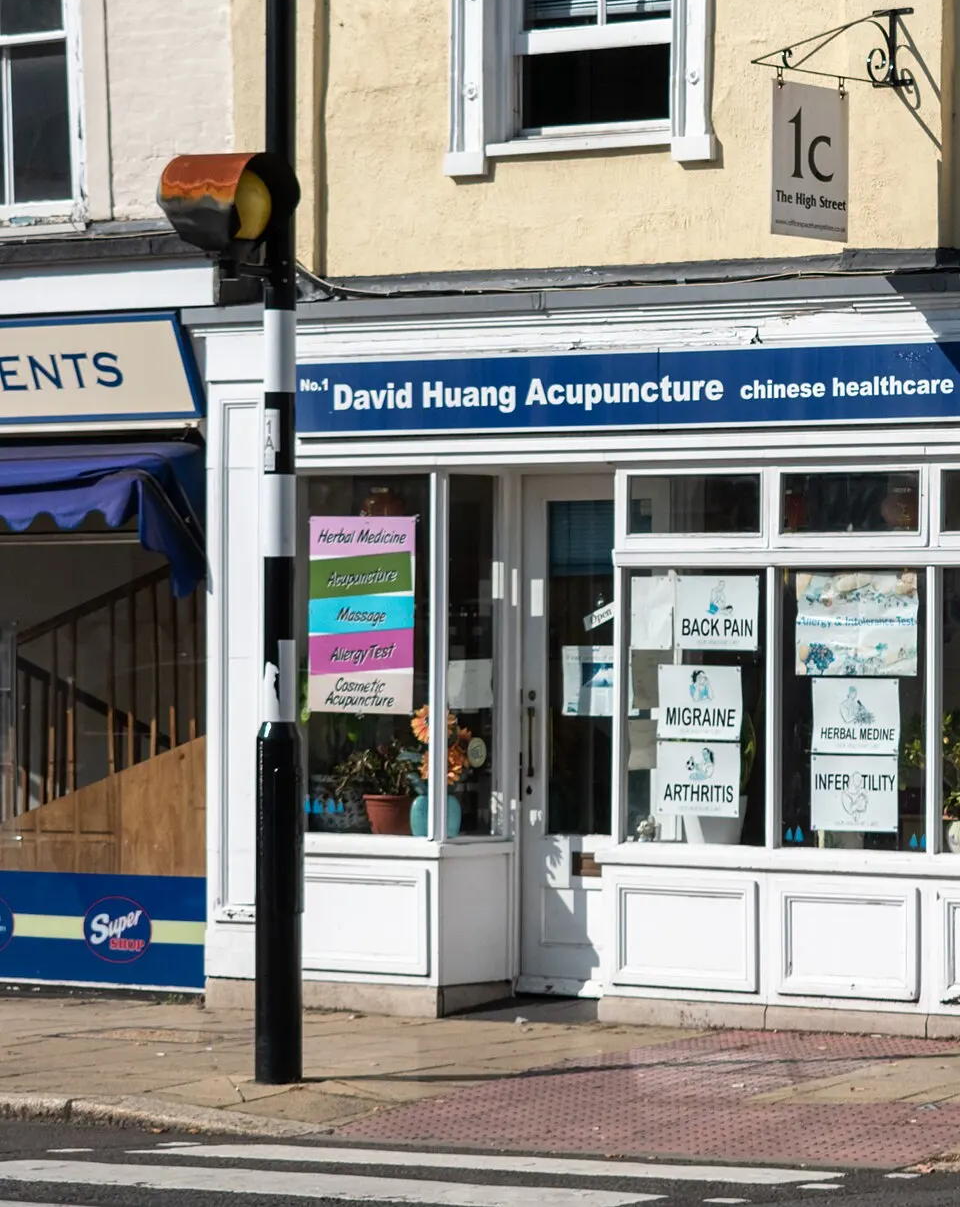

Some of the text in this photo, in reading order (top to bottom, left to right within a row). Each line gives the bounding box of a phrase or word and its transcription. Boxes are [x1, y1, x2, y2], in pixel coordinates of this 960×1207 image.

[776, 190, 847, 212] The High Street
[0, 351, 124, 392] ENTS
[300, 374, 954, 414] No.1 David Huang Acupuncture chinese healthcare
[318, 529, 407, 545] Herbal Medicine
[327, 567, 399, 590] Acupuncture
[336, 607, 387, 627] Massage
[590, 607, 613, 625] Open
[681, 618, 754, 638] BACK PAIN
[330, 642, 397, 666] Allergy Test
[335, 676, 386, 694] Cosmetic
[324, 691, 395, 711] Acupuncture
[665, 706, 737, 728] MIGRAINE
[820, 726, 896, 742] HERBAL MEDINE
[663, 783, 735, 804] ARTHRITIS
[90, 909, 143, 945] Super
[109, 937, 144, 952] SHOP
